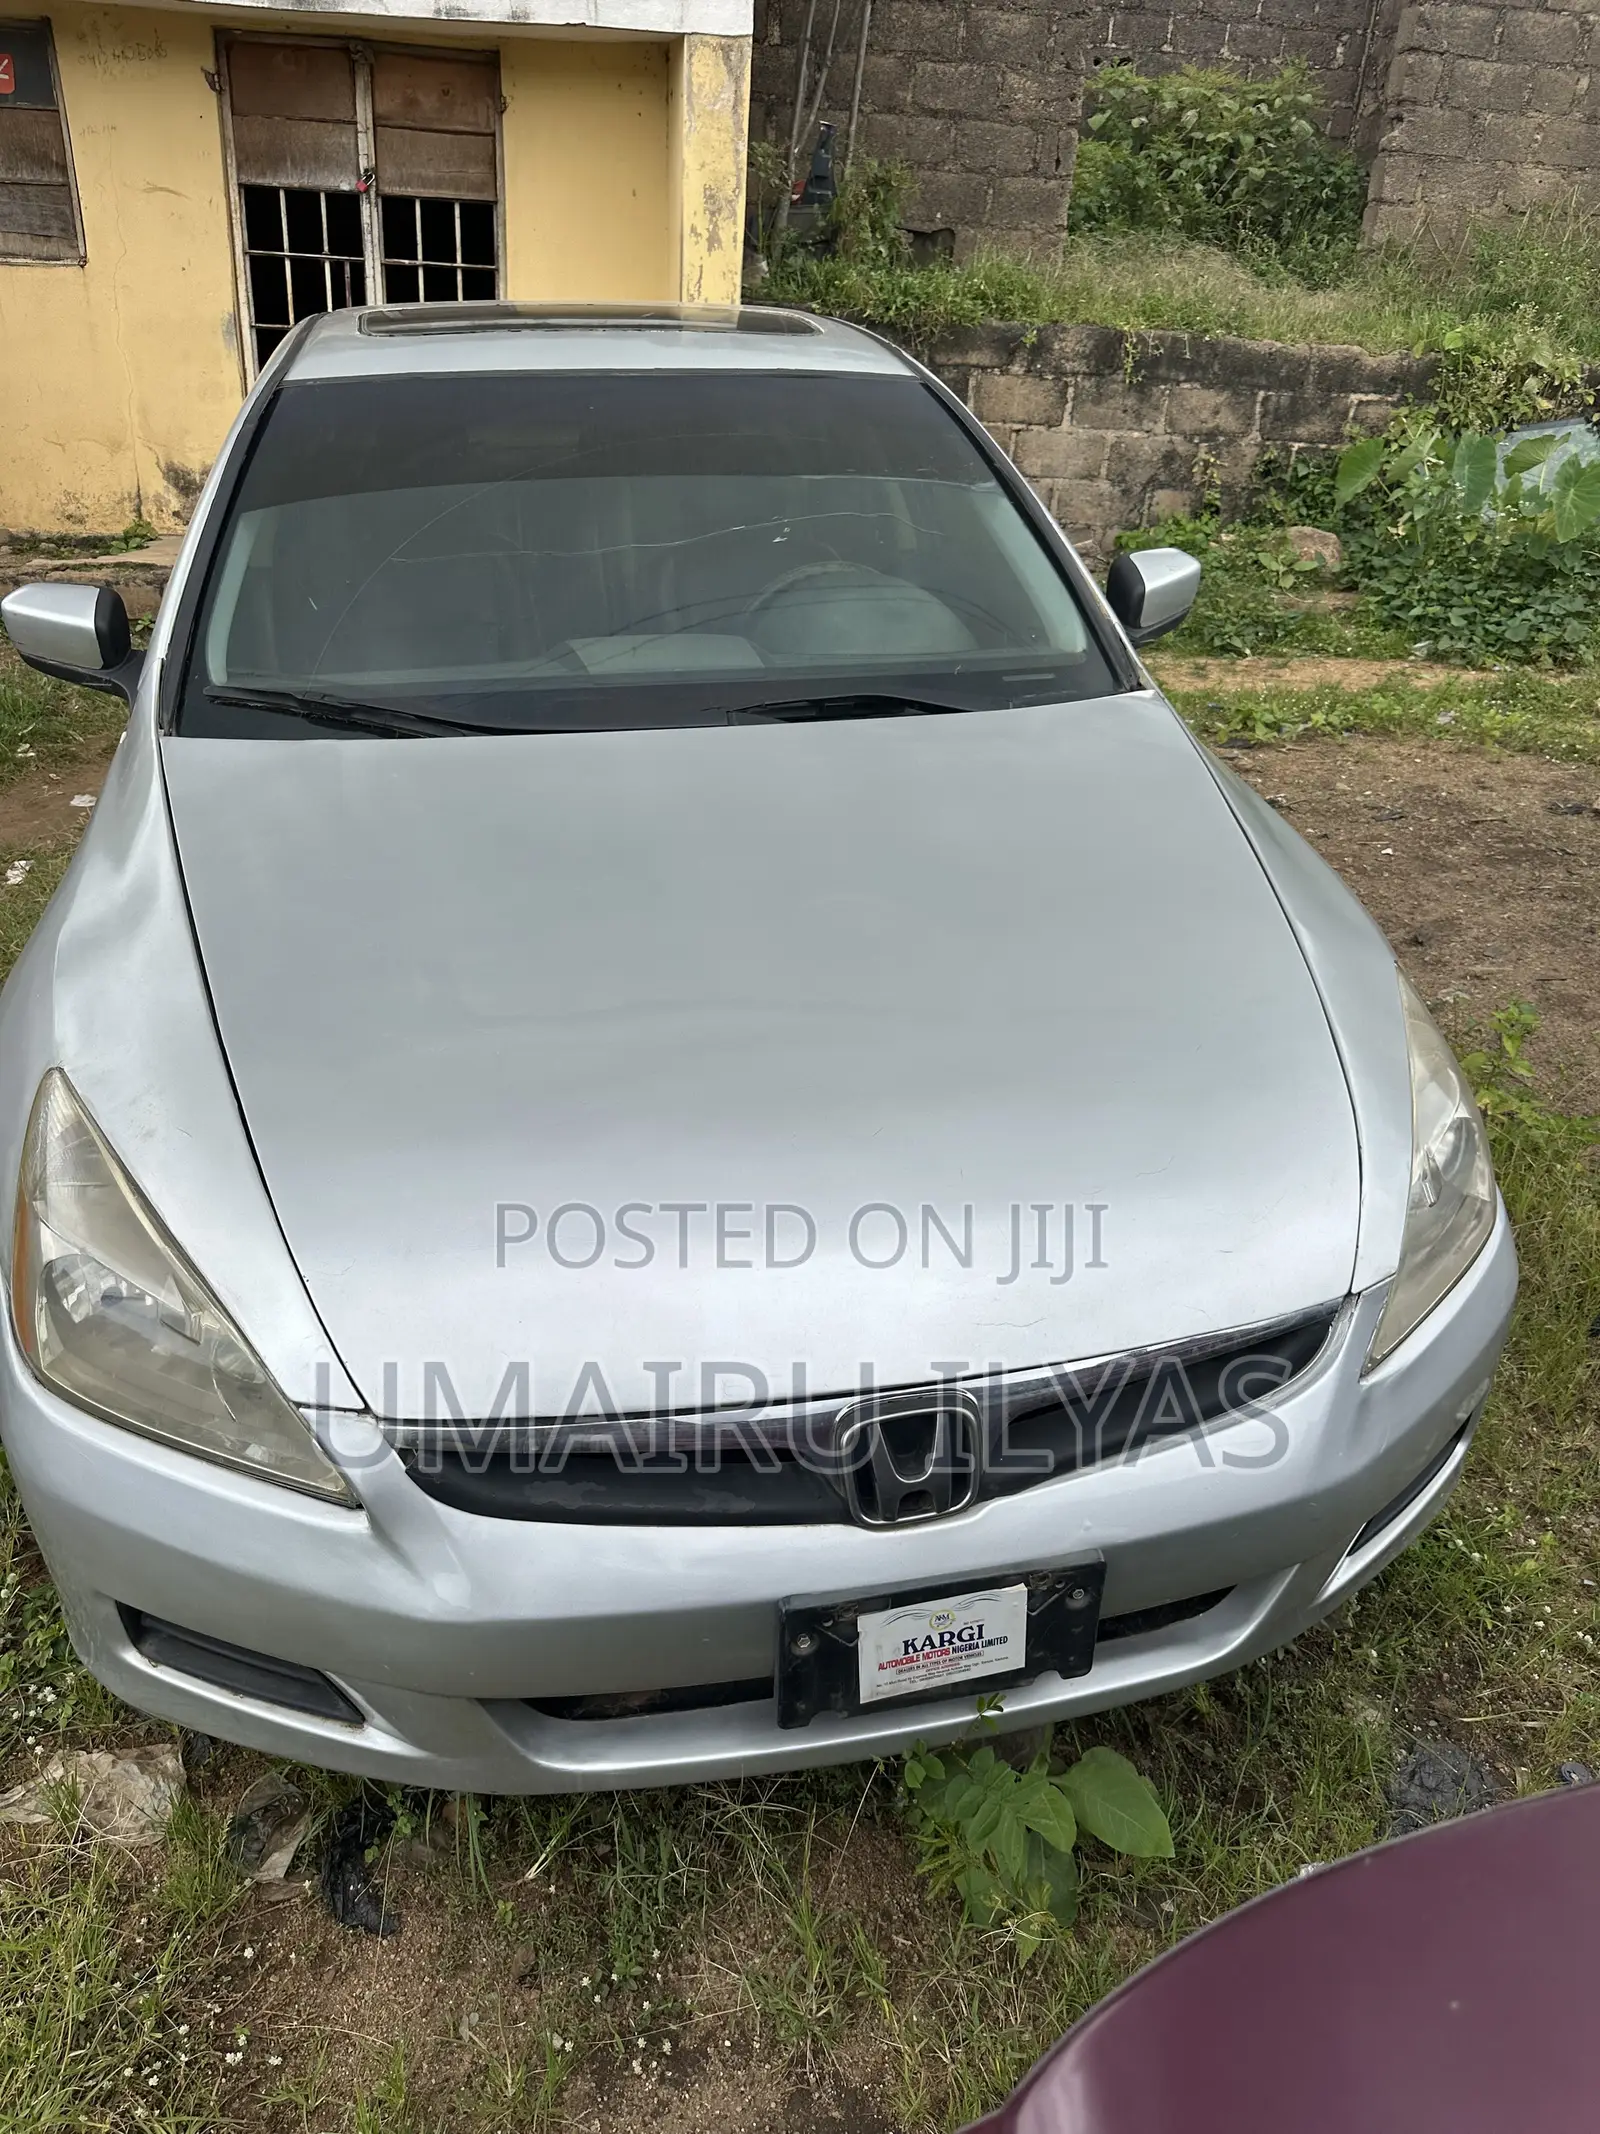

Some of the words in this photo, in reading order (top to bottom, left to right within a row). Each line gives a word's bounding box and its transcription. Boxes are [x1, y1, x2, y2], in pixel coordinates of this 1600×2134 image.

[878, 1654, 920, 1671] AUTOMOBILE
[922, 1647, 951, 1661] MOTORS
[952, 1641, 980, 1654] NIGERIA
[981, 1635, 1009, 1648] LIMITED
[902, 1624, 985, 1656] KARGI
